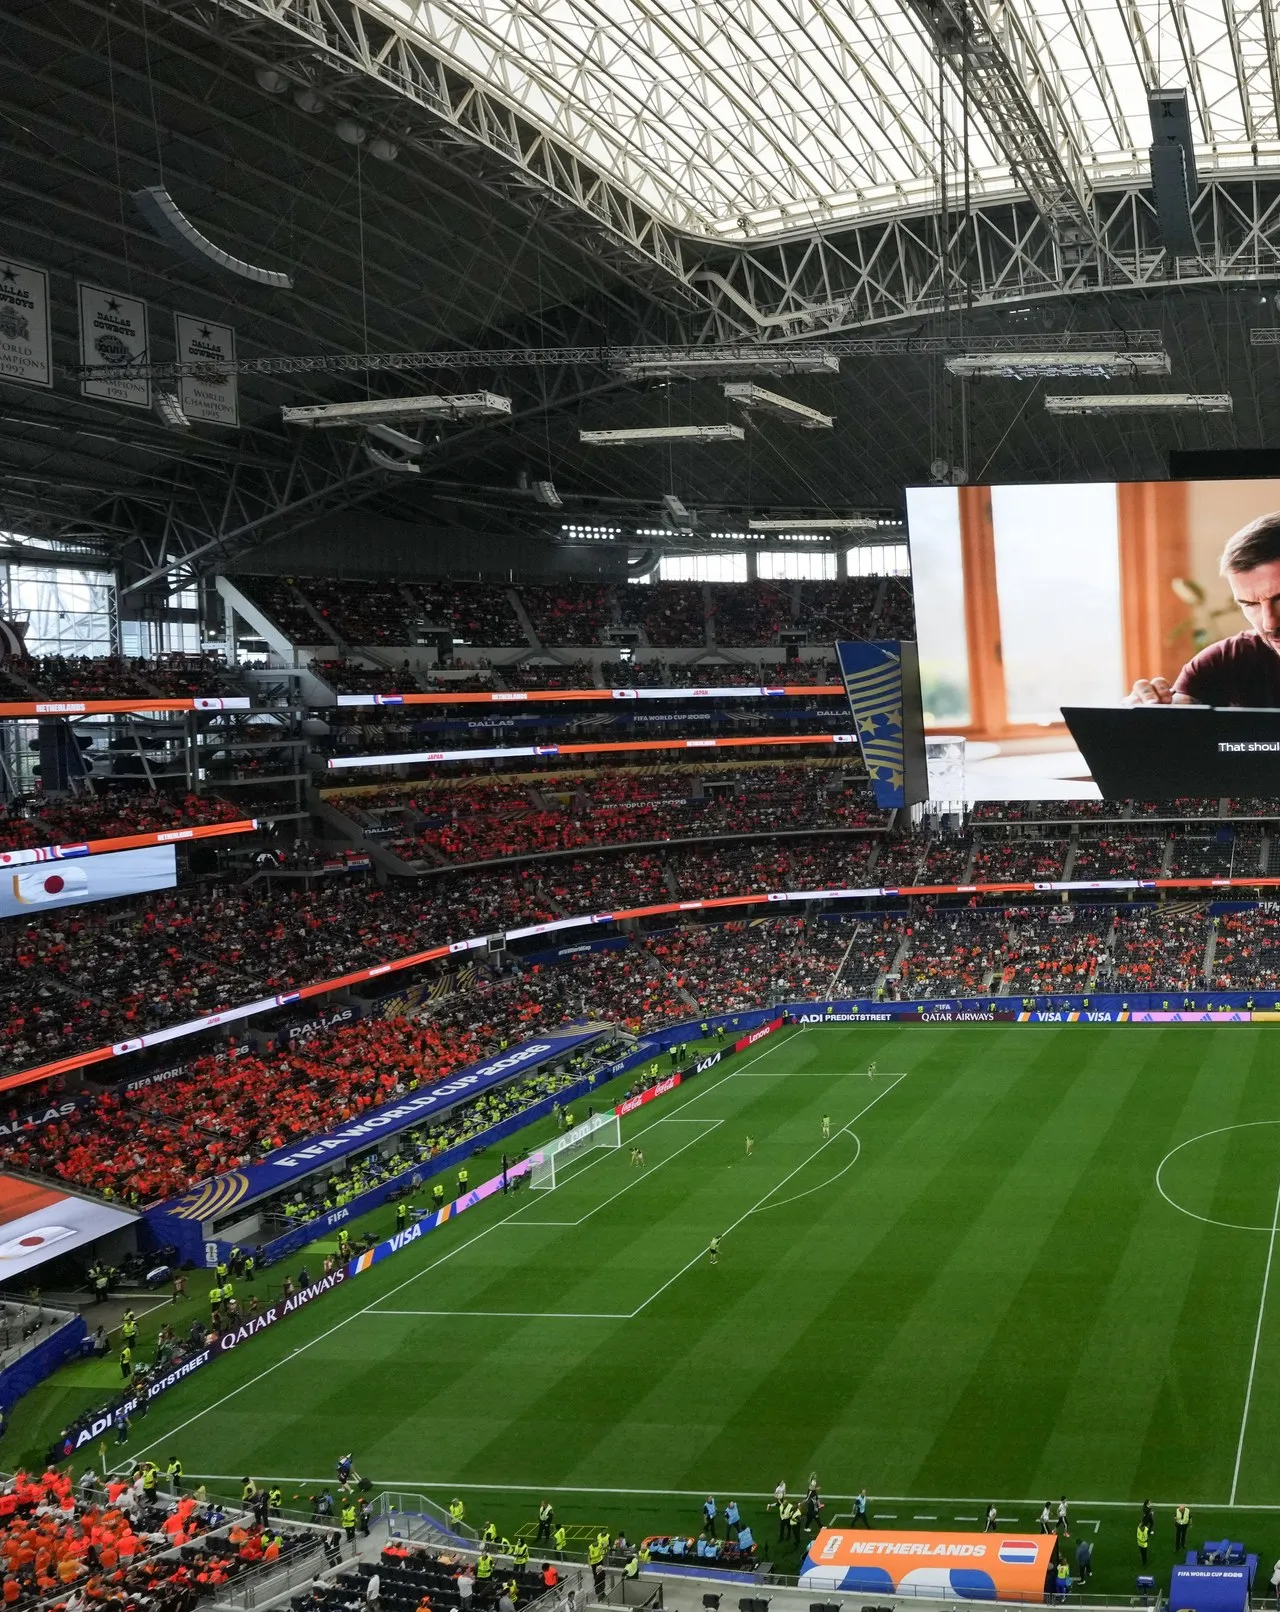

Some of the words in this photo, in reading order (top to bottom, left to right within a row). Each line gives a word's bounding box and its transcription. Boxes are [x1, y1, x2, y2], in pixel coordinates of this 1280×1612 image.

[97, 312, 131, 327] DALLAS
[94, 320, 136, 337] COWBOYS
[0, 343, 33, 357] ORLD
[191, 339, 222, 353] DALLAS
[193, 388, 225, 403] WORLD
[468, 719, 515, 728] DALLAS
[1218, 743, 1245, 752] That
[289, 1009, 352, 1039] DALLAS
[800, 1014, 824, 1023] ADI
[825, 1014, 891, 1022] PREDICTSTREET
[921, 1012, 953, 1022] QATAR
[955, 1012, 994, 1022] AIRWAYS
[1038, 1013, 1061, 1022] VISA
[1088, 1013, 1111, 1022] VISA
[749, 1027, 770, 1044] Lenovo
[612, 1062, 624, 1074] FIFA
[127, 1079, 151, 1091] FIFA
[152, 1064, 188, 1083] WORL
[654, 1079, 674, 1097] Coca-Cola
[273, 1137, 341, 1168] FIFA
[337, 1096, 437, 1145] WORLD
[432, 1075, 479, 1097] CUP
[475, 1044, 552, 1076] 2026
[0, 1102, 77, 1136] ALLAS
[327, 1208, 350, 1225] FIFA
[387, 1222, 422, 1252] VISA
[220, 1308, 277, 1350] QATAR
[282, 1268, 345, 1316] AIRWAYS
[76, 1413, 112, 1449] ADI
[850, 1541, 986, 1558] NETHERLANDS
